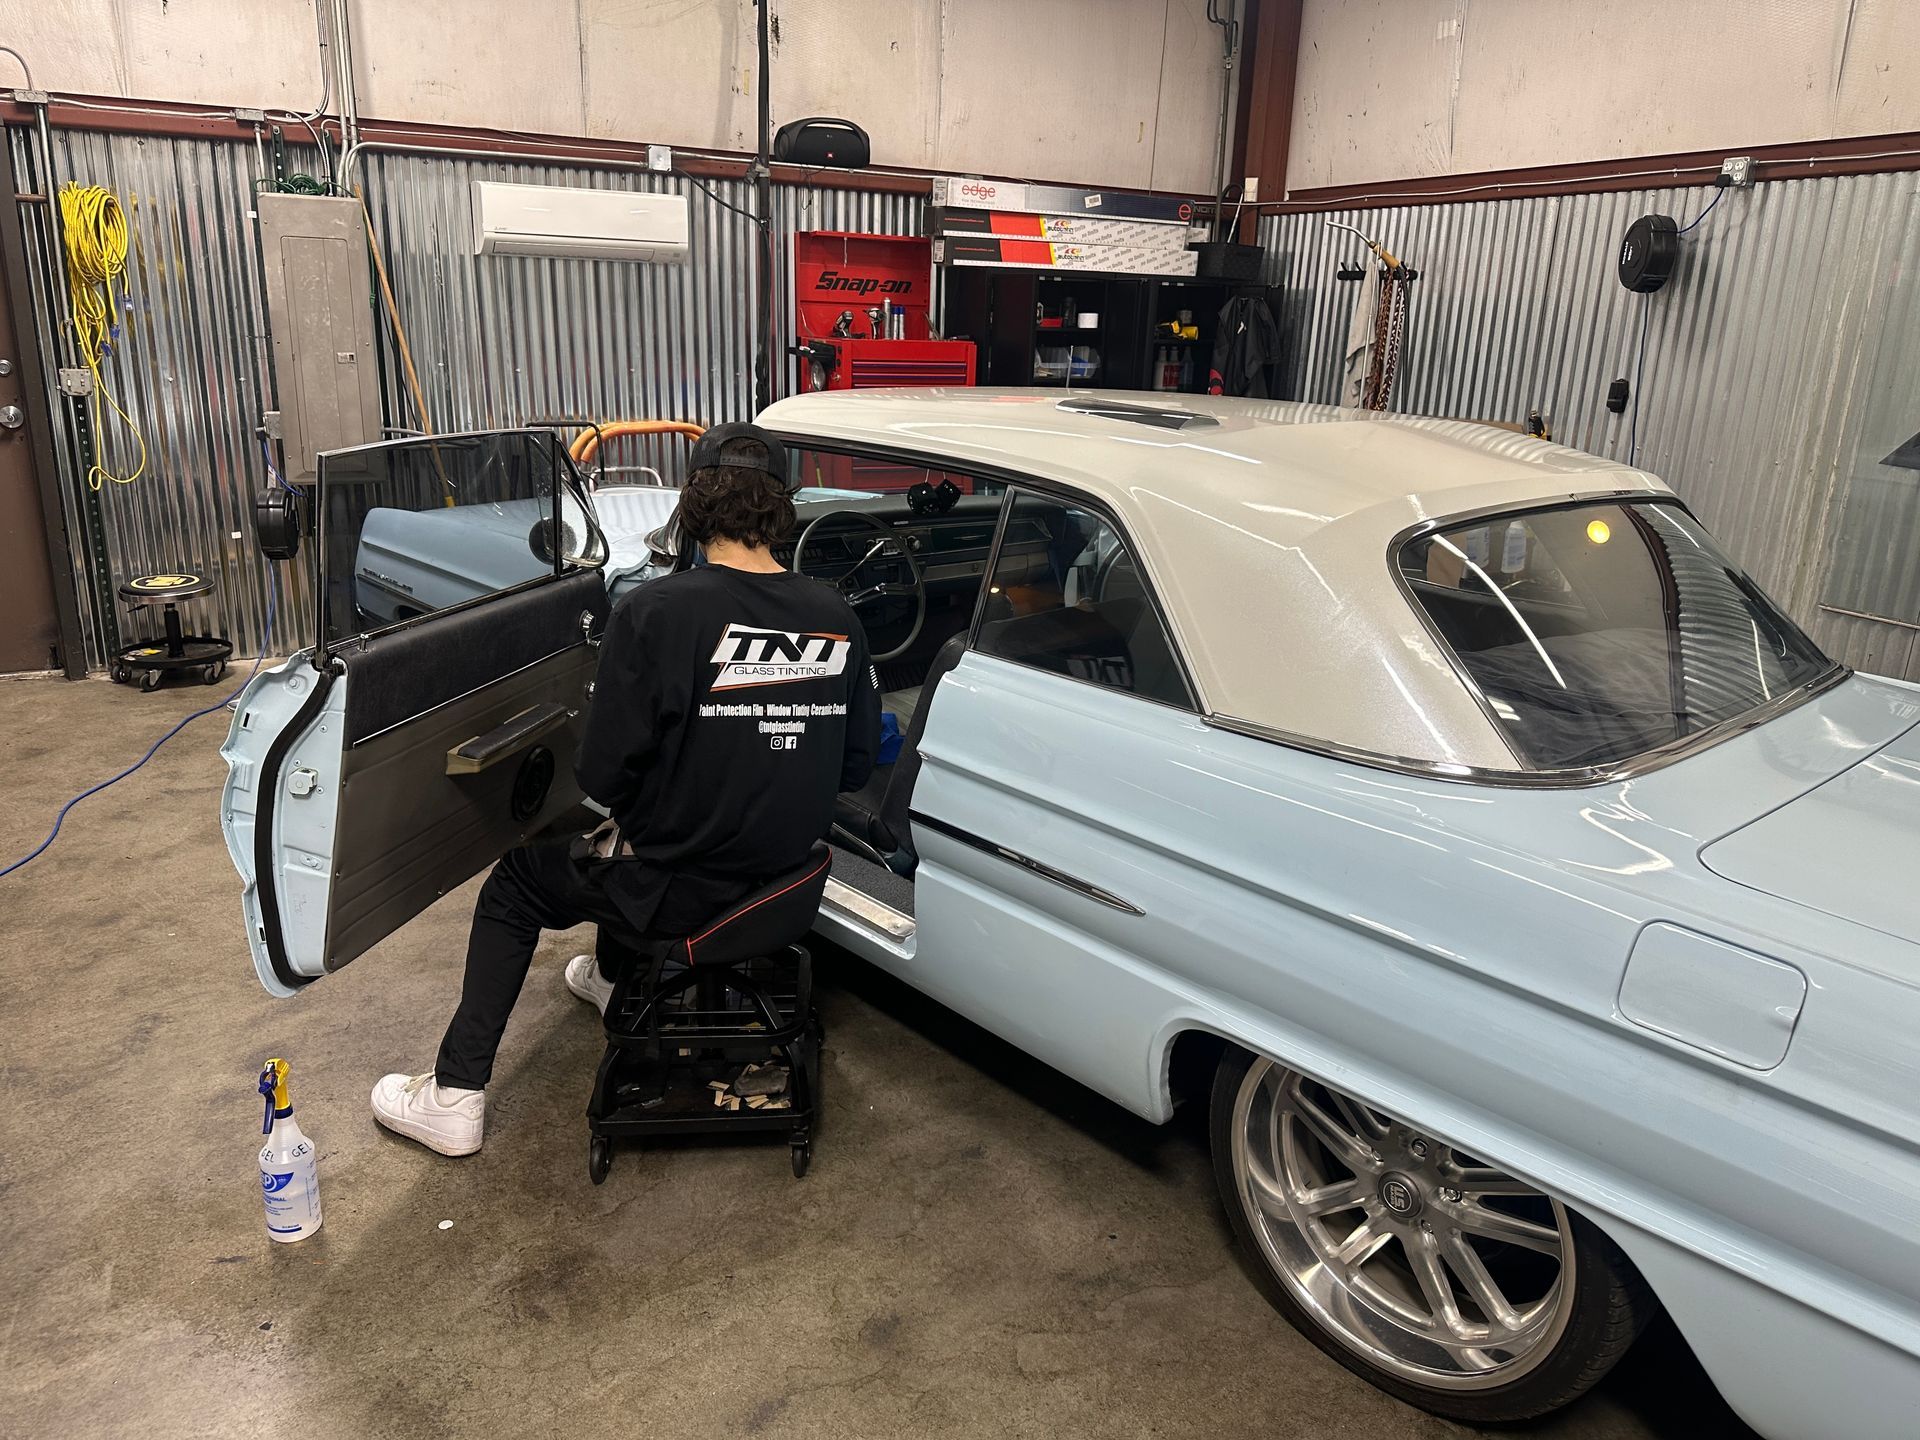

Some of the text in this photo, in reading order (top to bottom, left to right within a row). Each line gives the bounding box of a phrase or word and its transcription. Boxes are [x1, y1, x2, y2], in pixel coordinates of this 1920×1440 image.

[961, 183, 996, 200] edge
[815, 271, 912, 296] Snap-on
[727, 631, 836, 662] TNT
[734, 666, 827, 675] GLASS TINTING
[716, 704, 752, 717] Protection
[261, 1148, 275, 1163] GEL
[291, 1142, 313, 1158] GEL
